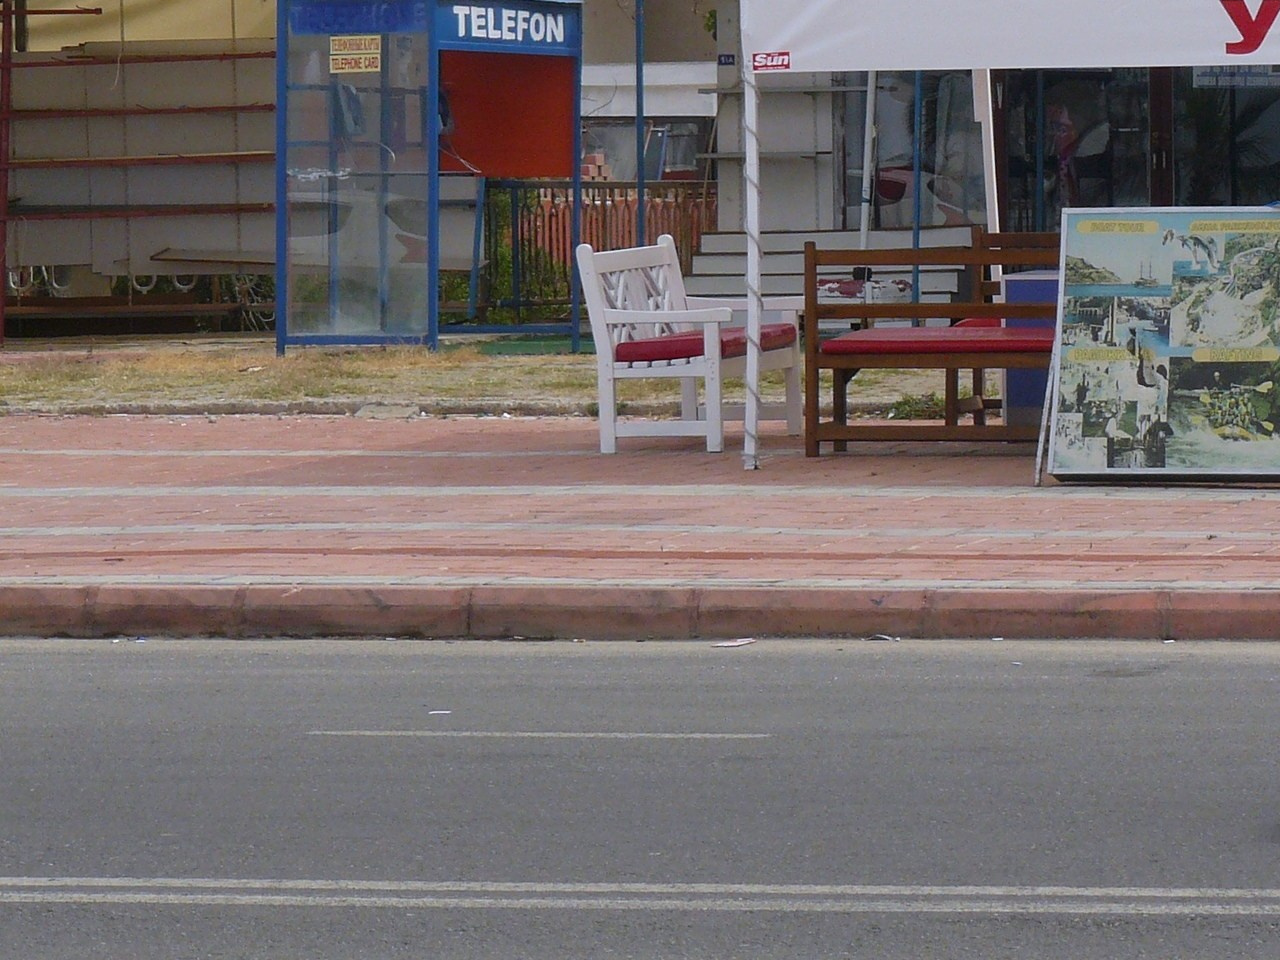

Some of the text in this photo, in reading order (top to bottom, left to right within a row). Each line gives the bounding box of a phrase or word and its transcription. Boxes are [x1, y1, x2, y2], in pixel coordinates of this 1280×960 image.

[453, 5, 564, 43] TELEFON
[331, 56, 379, 70] TELEPHONE CARD
[754, 53, 789, 66] Sun
